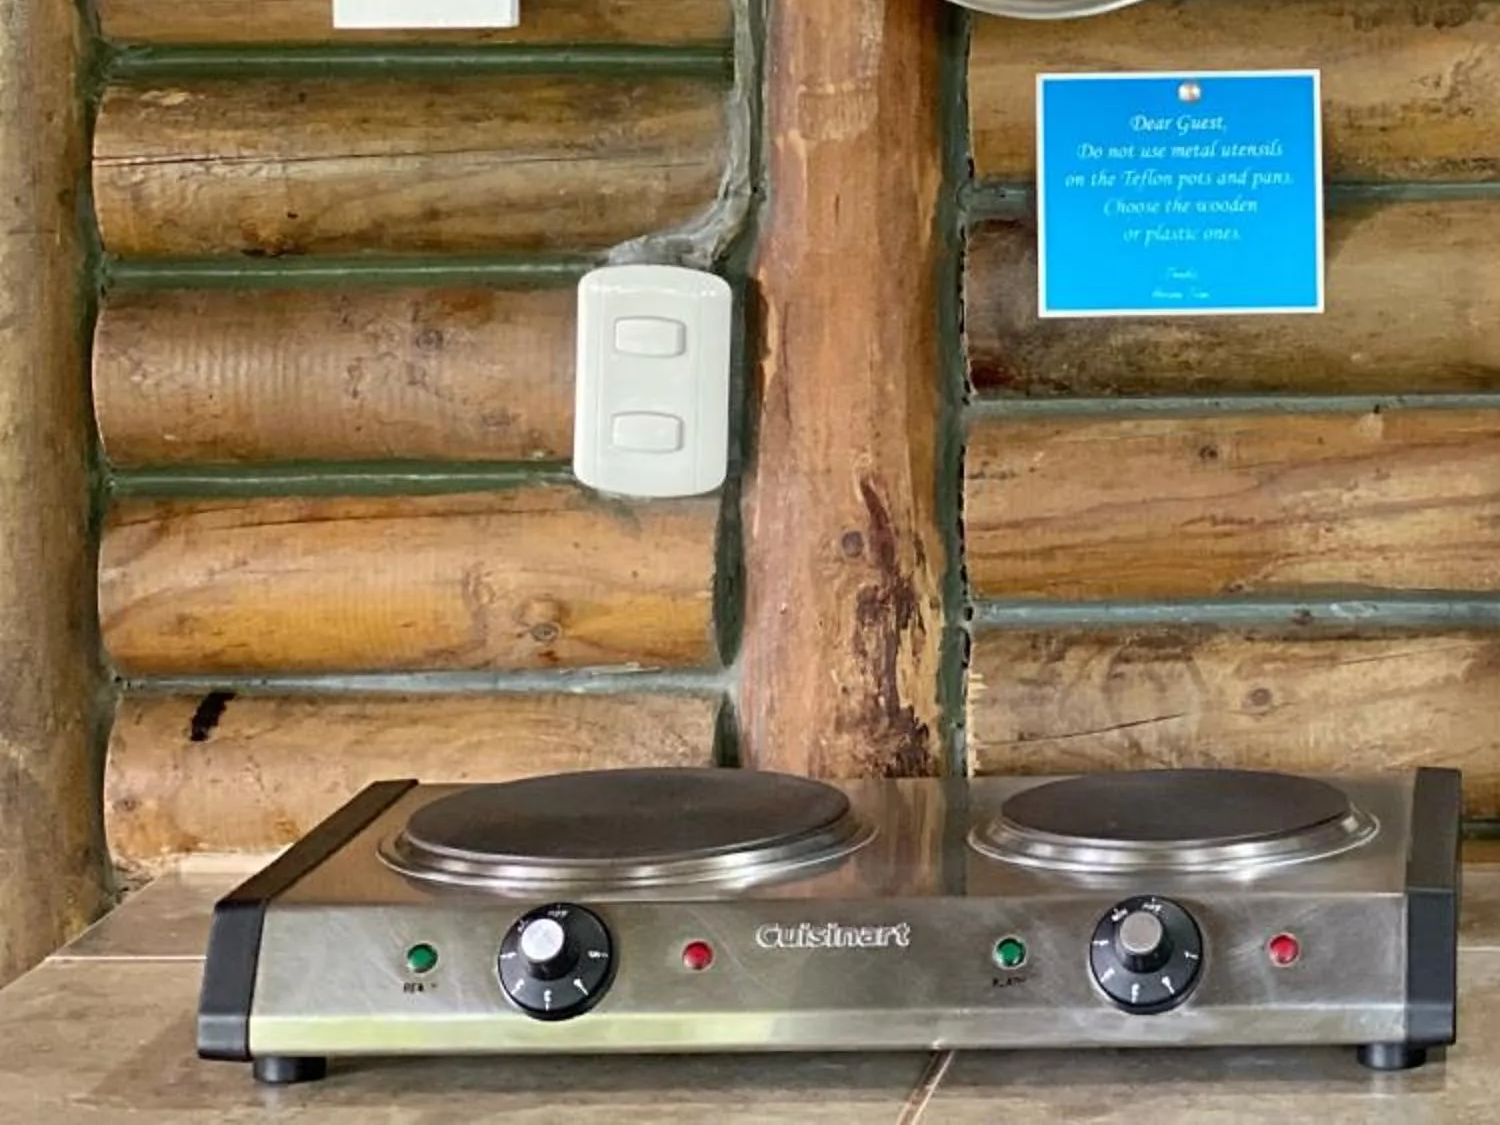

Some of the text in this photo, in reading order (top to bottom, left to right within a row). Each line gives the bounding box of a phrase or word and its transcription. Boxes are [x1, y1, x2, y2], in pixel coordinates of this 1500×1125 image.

[1129, 114, 1227, 136] Dear Guest,
[1077, 138, 1284, 159] Do not use metal utensils
[1065, 174, 1085, 187] on
[1091, 169, 1116, 187] the
[1122, 168, 1173, 191] Teflon
[1177, 173, 1211, 191] pots
[1216, 167, 1252, 186] and
[1103, 194, 1258, 216] Choose the wooden
[1123, 228, 1140, 242] or
[1144, 224, 1197, 248] plastic
[755, 922, 911, 948] Cuisinart
